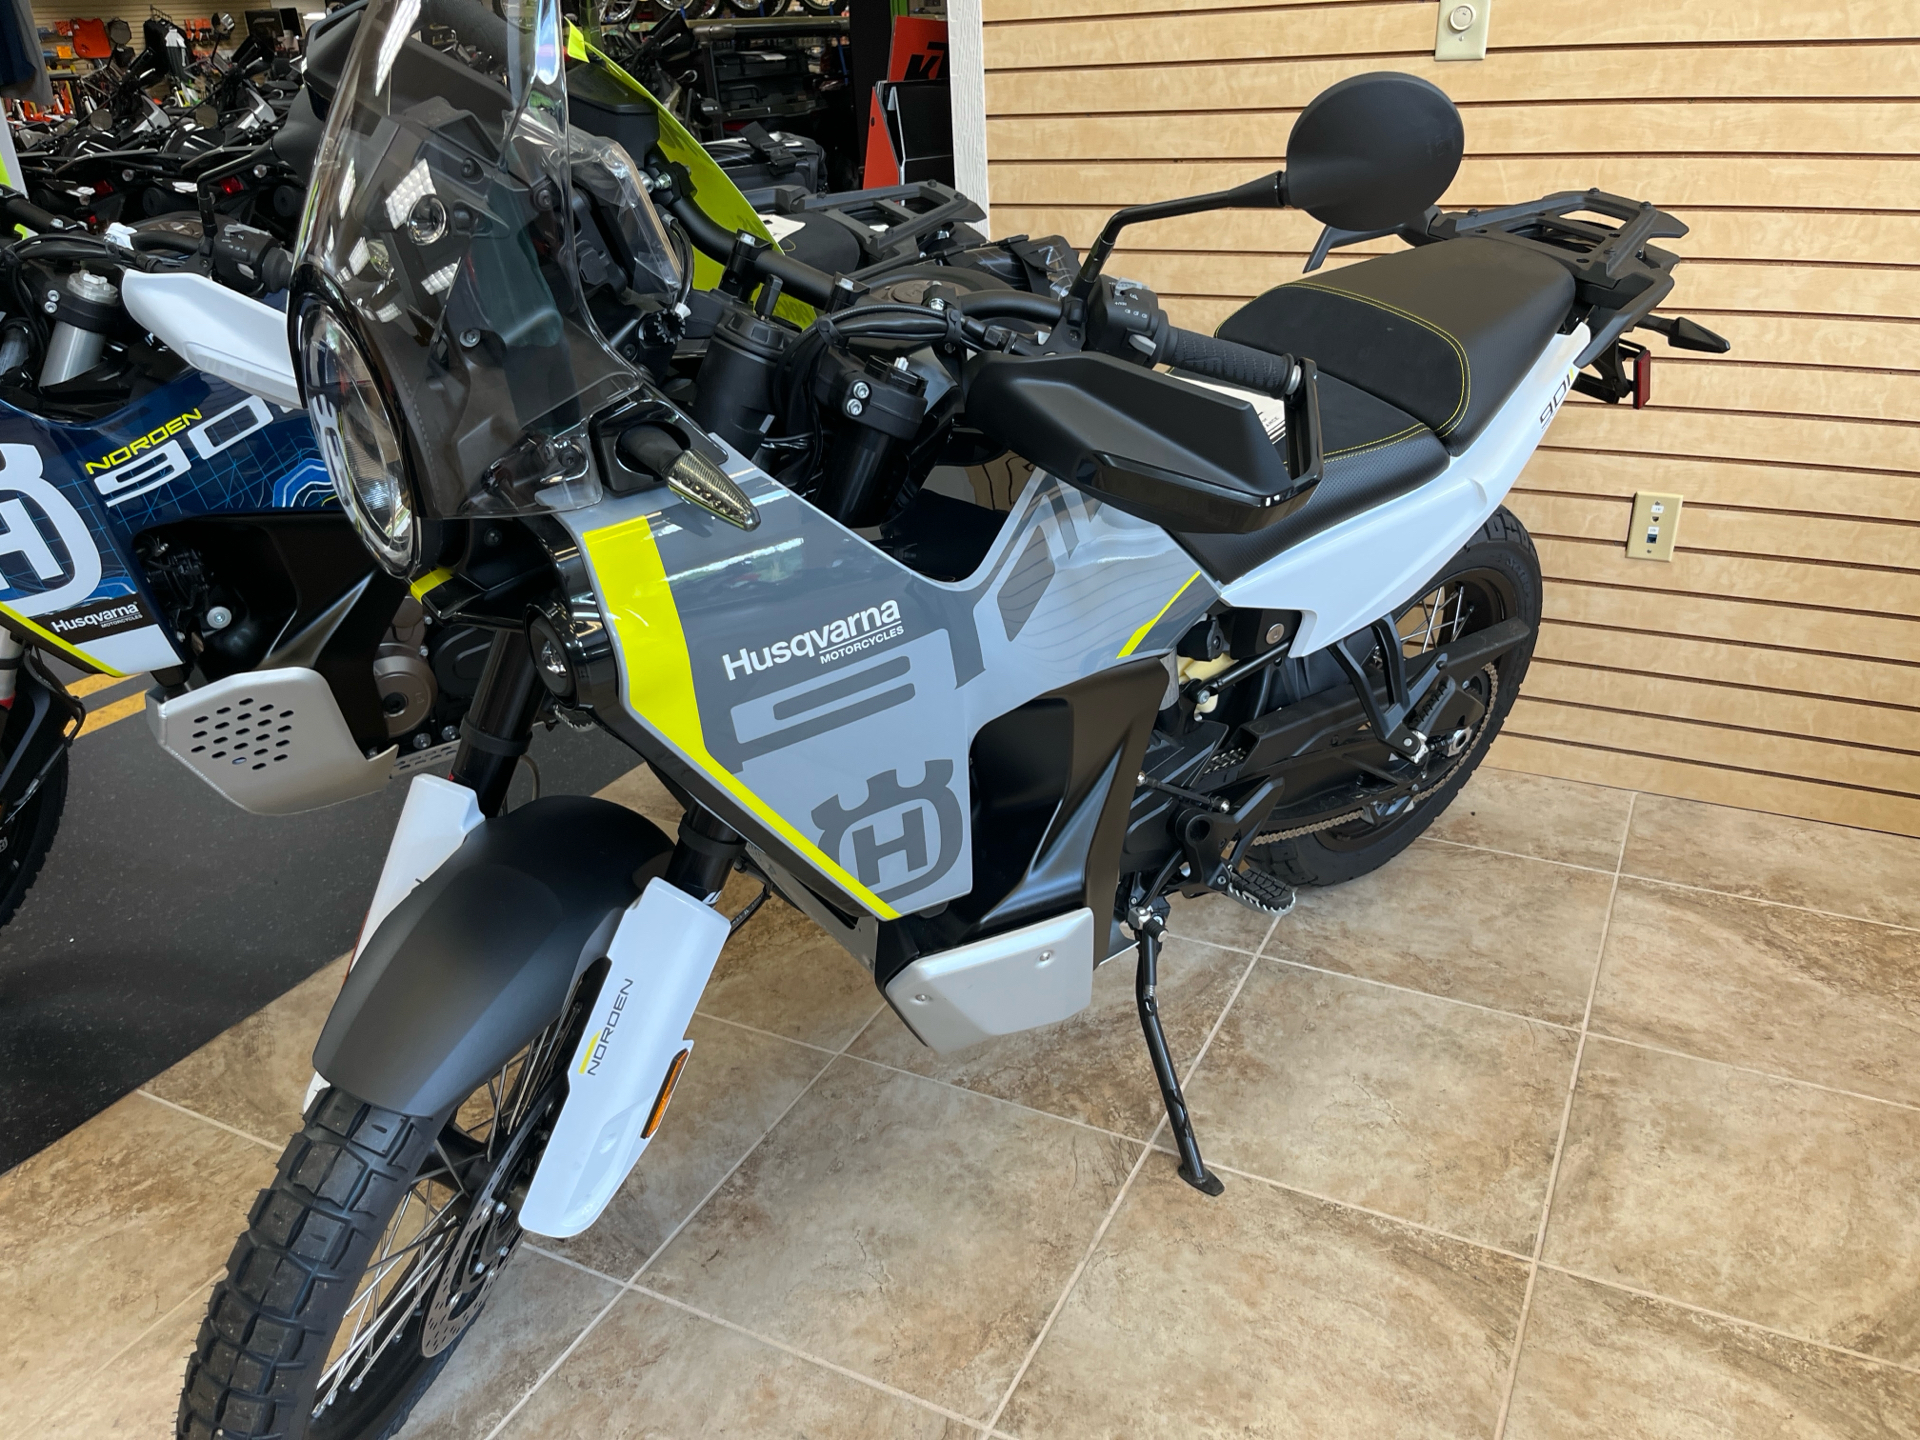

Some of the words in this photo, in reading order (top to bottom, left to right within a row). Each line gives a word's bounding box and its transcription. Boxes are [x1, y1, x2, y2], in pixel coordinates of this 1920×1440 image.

[1539, 373, 1571, 430] 901
[85, 407, 203, 475] NORDEN
[94, 394, 304, 508] 90
[51, 602, 139, 634] Husqvarna
[101, 613, 144, 629] MOTORCYCLES
[722, 600, 902, 681] Husqvarna
[820, 624, 905, 665] MOTORCYCLES
[587, 977, 634, 1077] NORDEN
